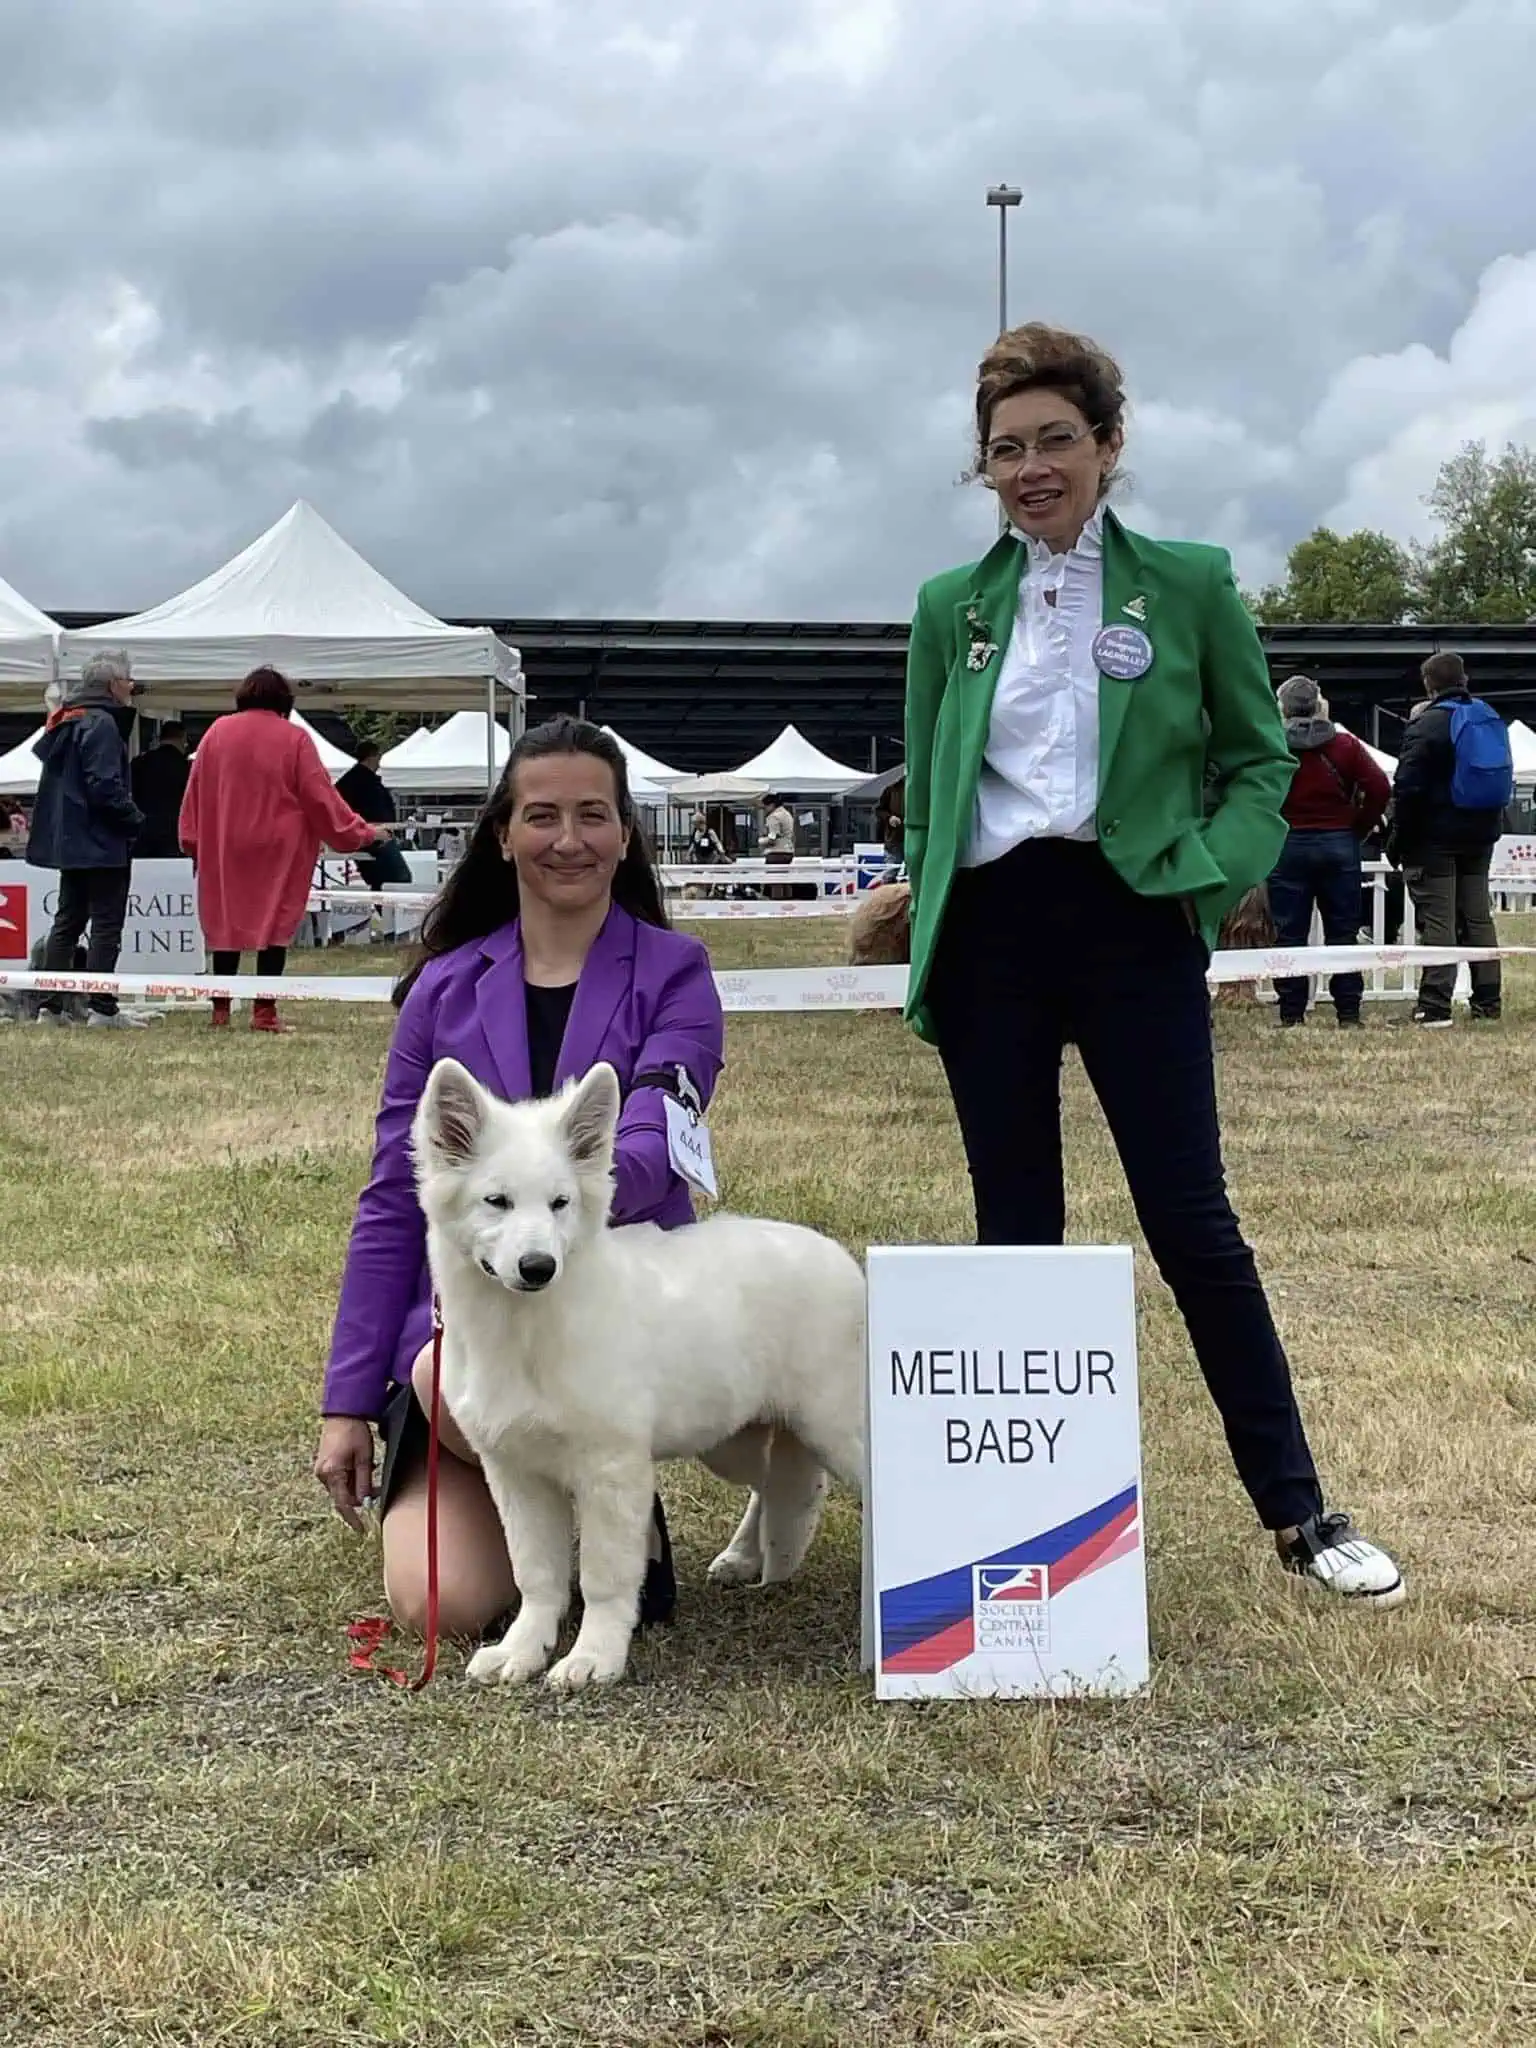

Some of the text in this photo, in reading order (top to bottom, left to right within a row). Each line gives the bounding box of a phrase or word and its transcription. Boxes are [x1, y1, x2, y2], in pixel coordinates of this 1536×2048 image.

[43, 889, 195, 918] CRALE
[891, 1349, 1117, 1395] MEILLEUR
[946, 1418, 1065, 1464] BABY
